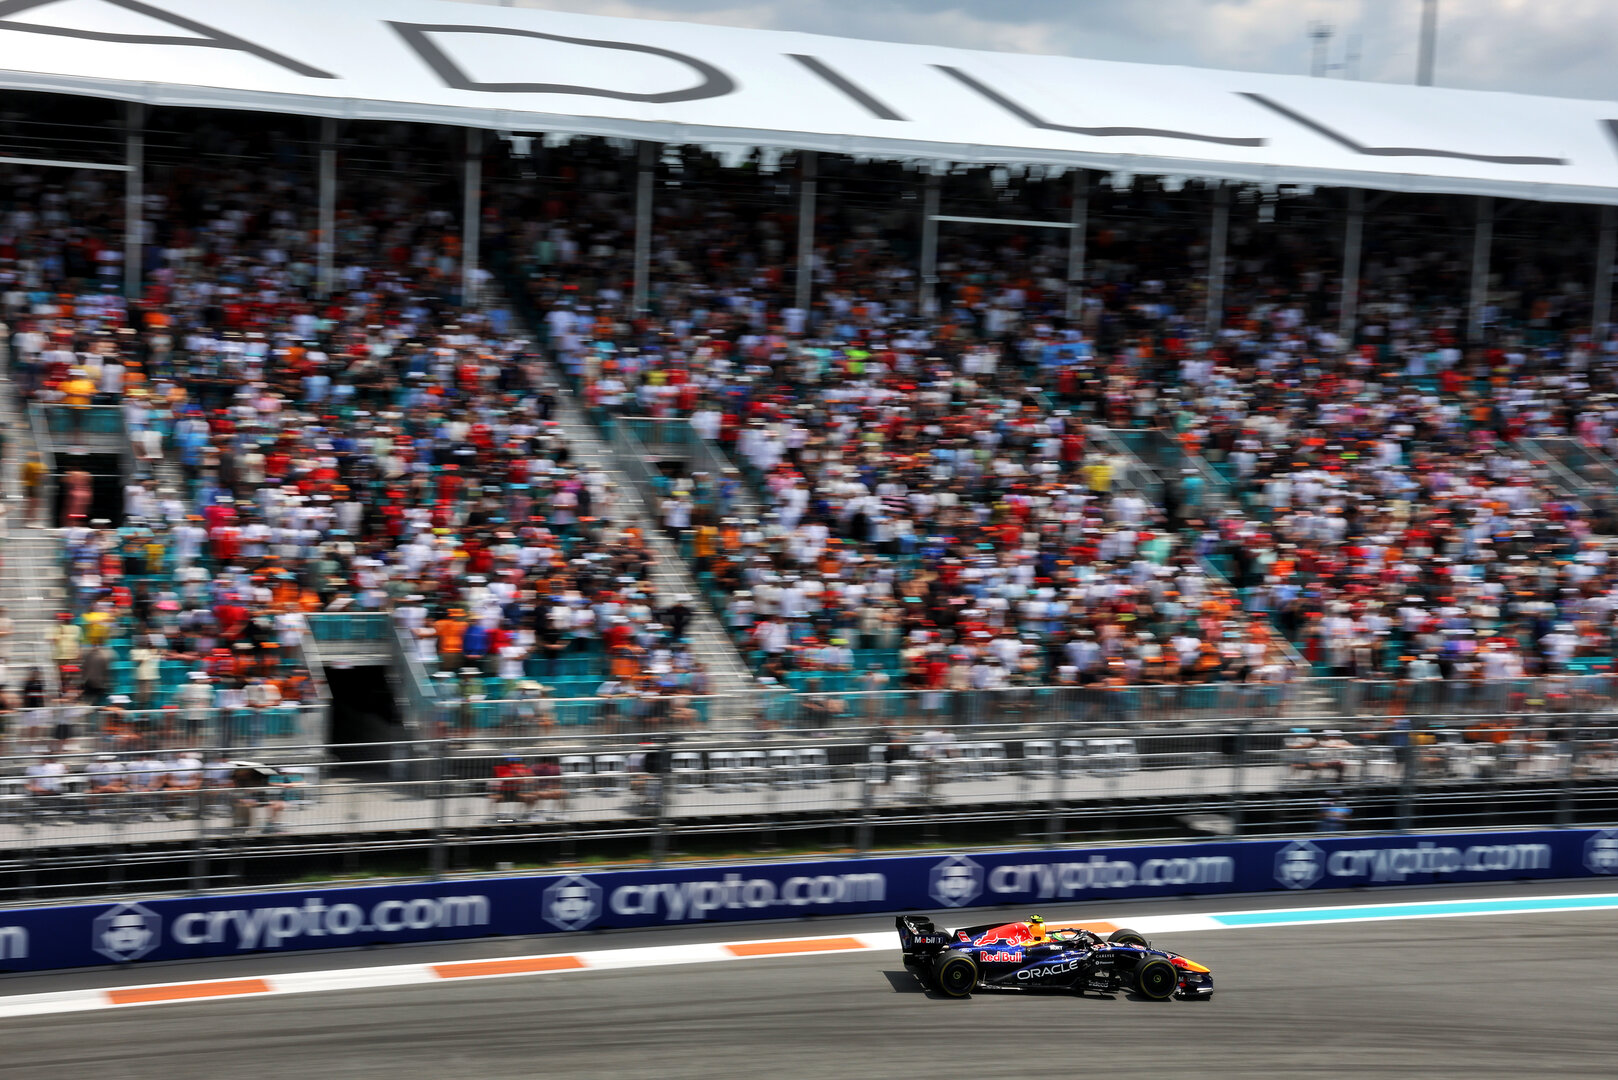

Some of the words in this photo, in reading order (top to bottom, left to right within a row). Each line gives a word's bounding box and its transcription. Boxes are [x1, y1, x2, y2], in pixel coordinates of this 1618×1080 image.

[0, 0, 1618, 166] ADILL
[988, 854, 1236, 898] crypto.com
[1327, 841, 1552, 882] crypto.com
[611, 871, 887, 921] crypto.com
[171, 894, 490, 949] crypto.com
[914, 936, 936, 944] Mobil
[979, 950, 1000, 963] Red
[1001, 951, 1022, 963] Bull
[1016, 960, 1079, 980] ORACLE
